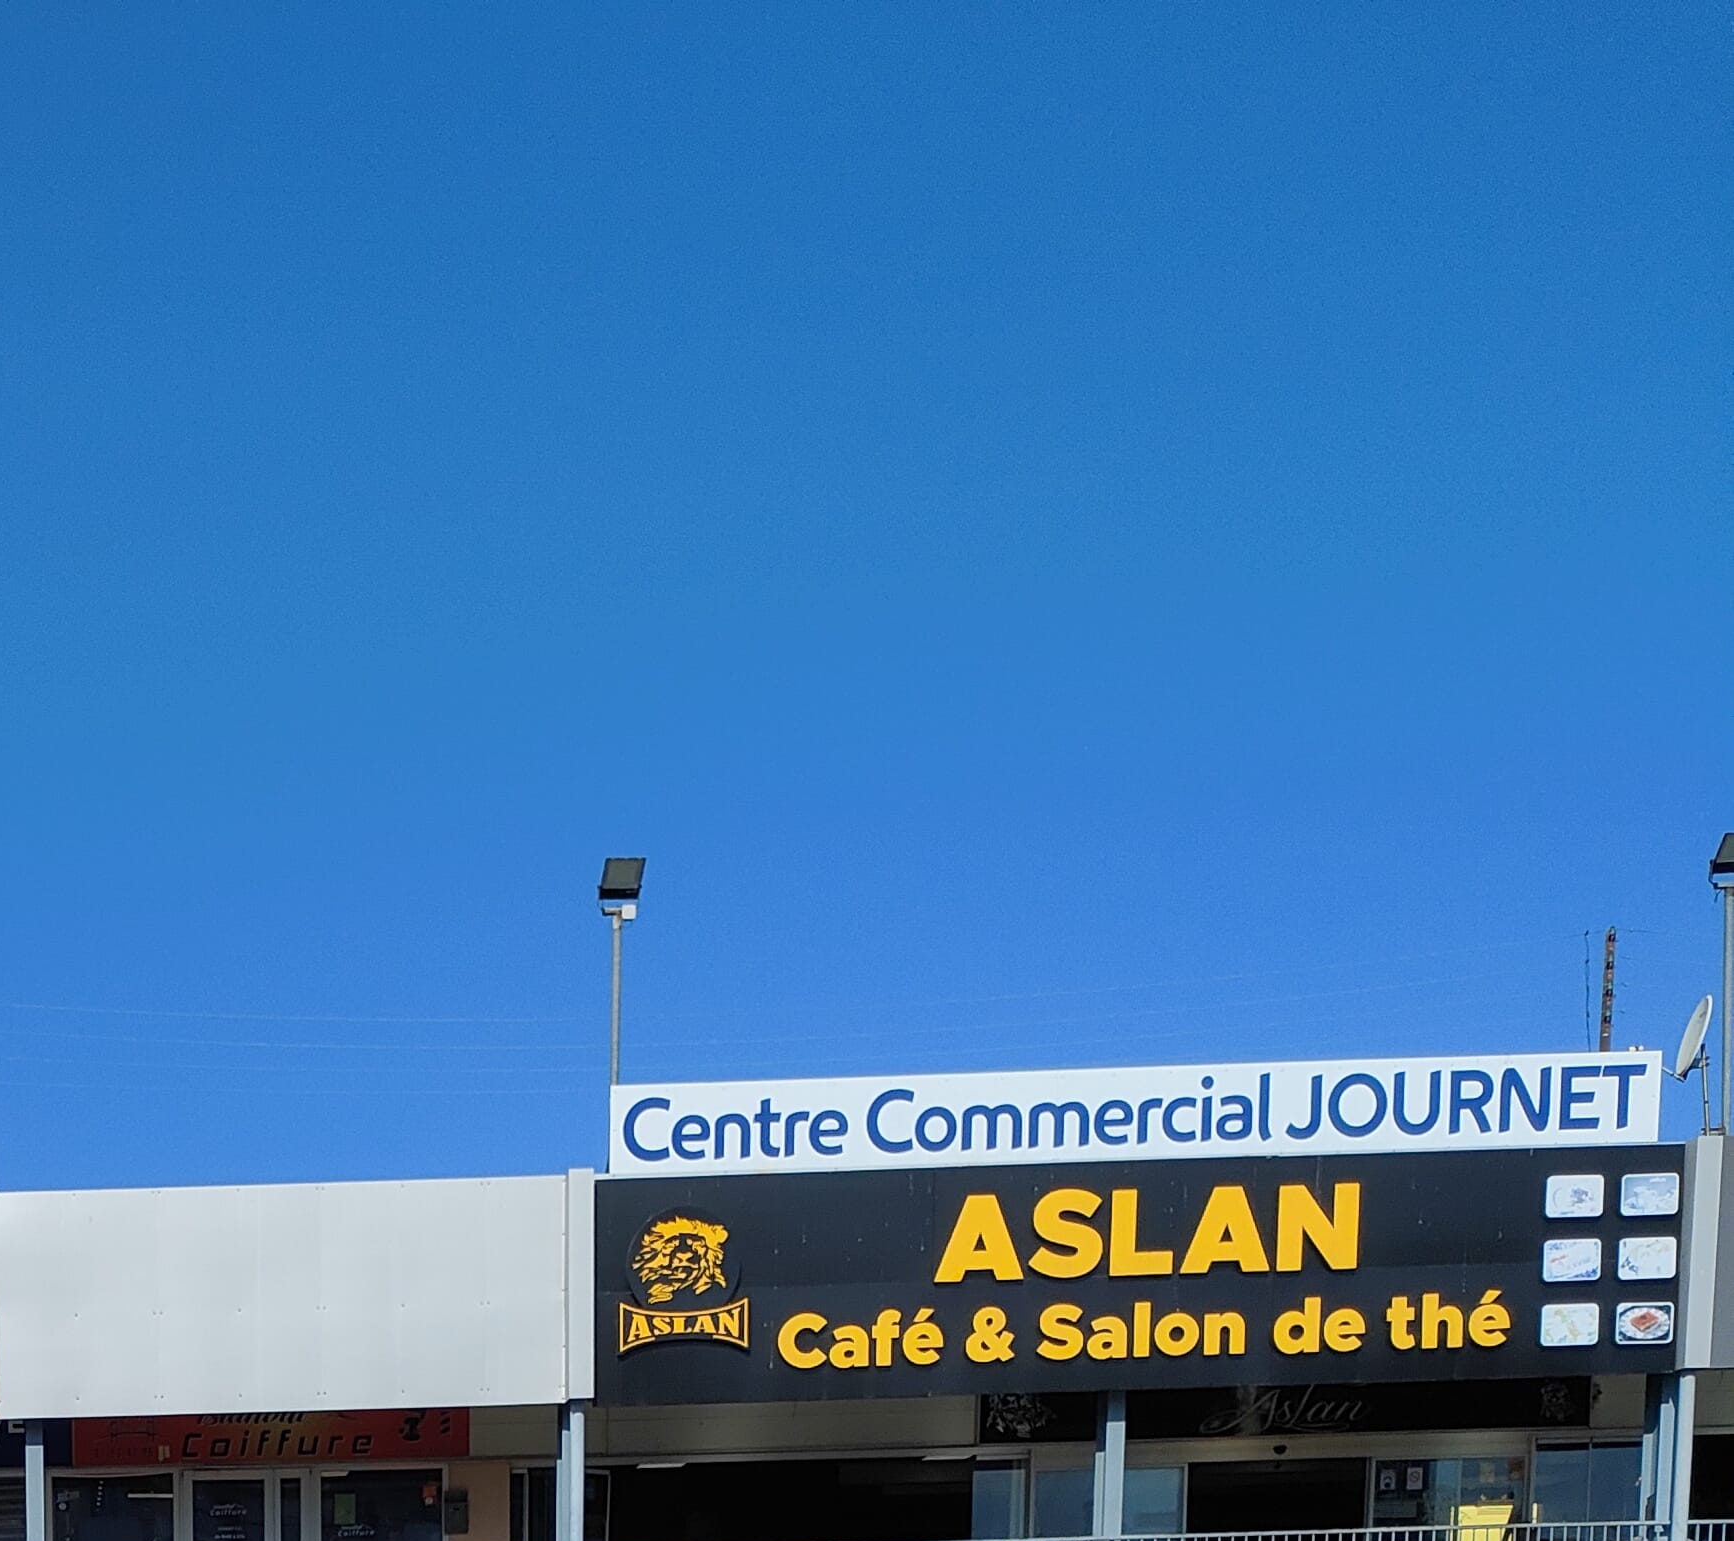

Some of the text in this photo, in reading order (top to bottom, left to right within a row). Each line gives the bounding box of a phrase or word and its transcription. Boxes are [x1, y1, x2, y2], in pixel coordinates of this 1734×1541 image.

[622, 1064, 1647, 1162] Centre Commercial JOURNET
[934, 1183, 1360, 1283] ASLAN
[627, 1308, 744, 1343] ASLAN
[777, 1289, 1512, 1369] Café & Salon de thé
[1199, 1384, 1366, 1435] Aslan
[181, 1429, 374, 1459] Coiffure
